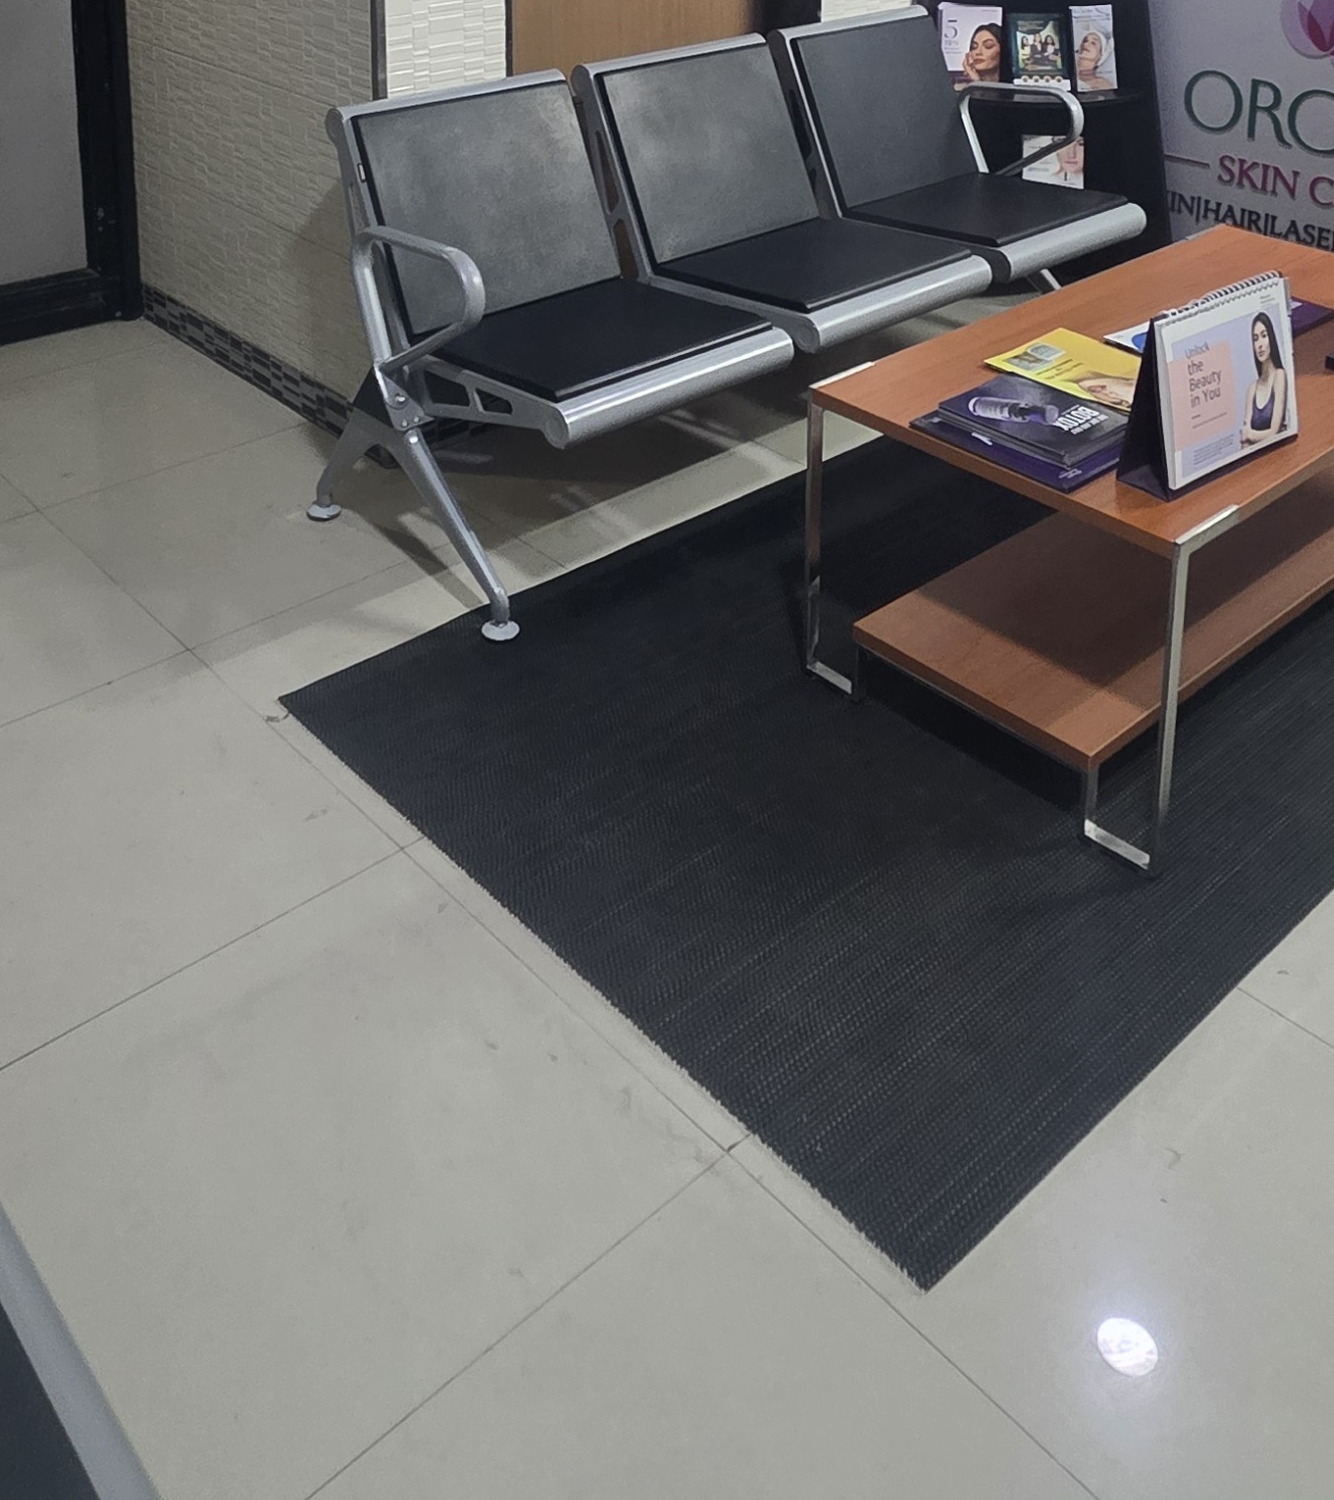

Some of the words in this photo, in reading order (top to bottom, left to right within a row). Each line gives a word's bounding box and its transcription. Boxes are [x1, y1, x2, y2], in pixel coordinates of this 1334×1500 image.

[944, 19, 958, 39] 5
[1218, 154, 1300, 200] SKIN
[1187, 360, 1204, 376] the
[1189, 370, 1222, 392] Beauty
[1190, 394, 1201, 408] in
[1202, 387, 1221, 403] You
